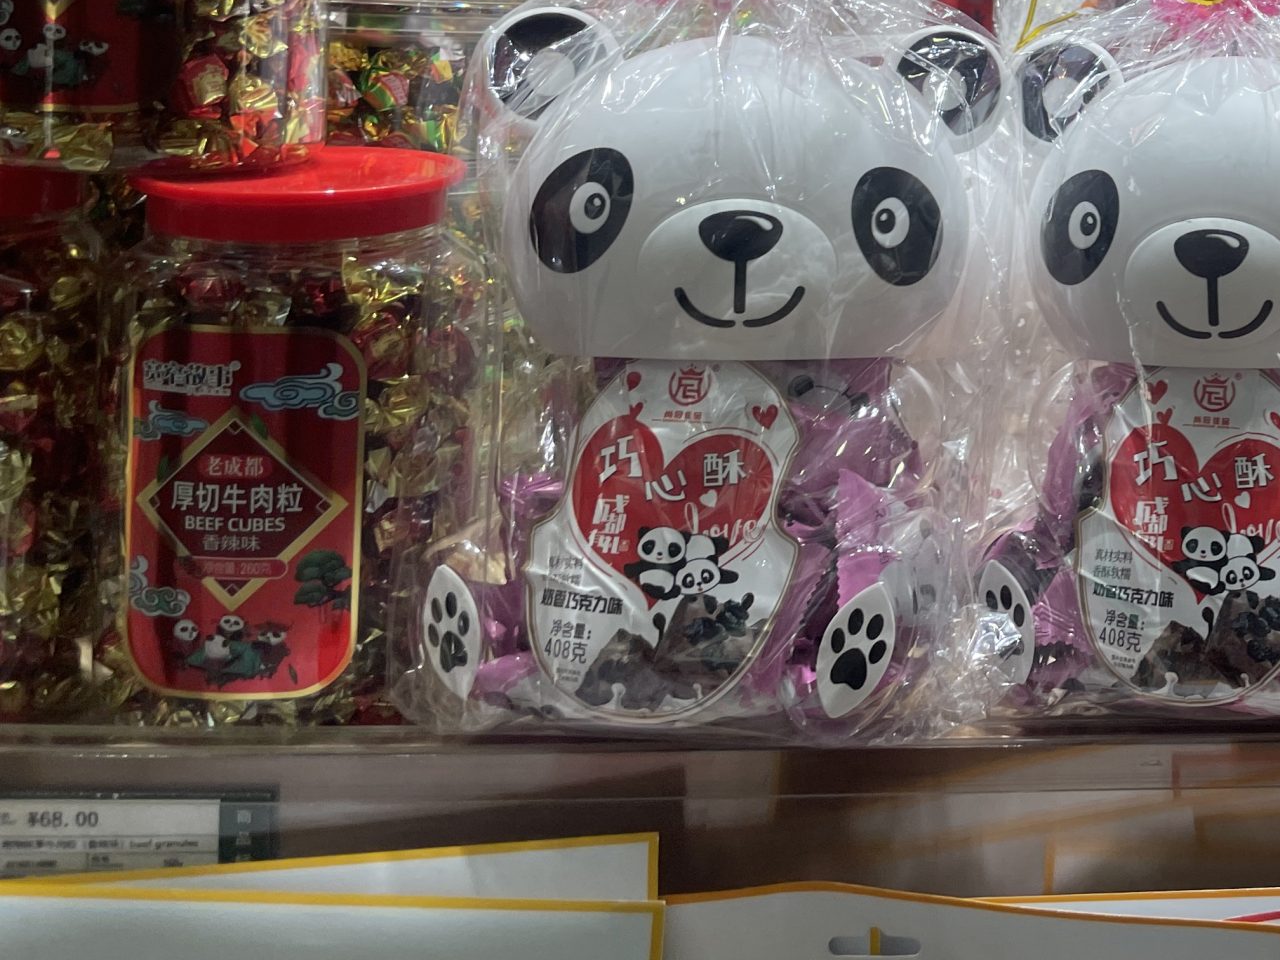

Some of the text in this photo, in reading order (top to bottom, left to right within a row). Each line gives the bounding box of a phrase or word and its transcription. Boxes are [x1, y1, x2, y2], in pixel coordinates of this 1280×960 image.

[207, 456, 264, 477] 老成都
[171, 480, 303, 515] 厚切牛肉粒
[184, 515, 286, 533] BEEF CUBES
[202, 534, 262, 552] 香辣味
[540, 587, 624, 615] 奶香巧克力味
[1092, 581, 1175, 608] 奶香巧克力味
[543, 637, 589, 664] 408克
[1098, 626, 1143, 653] 408克
[27, 811, 99, 828] ¥68.00
